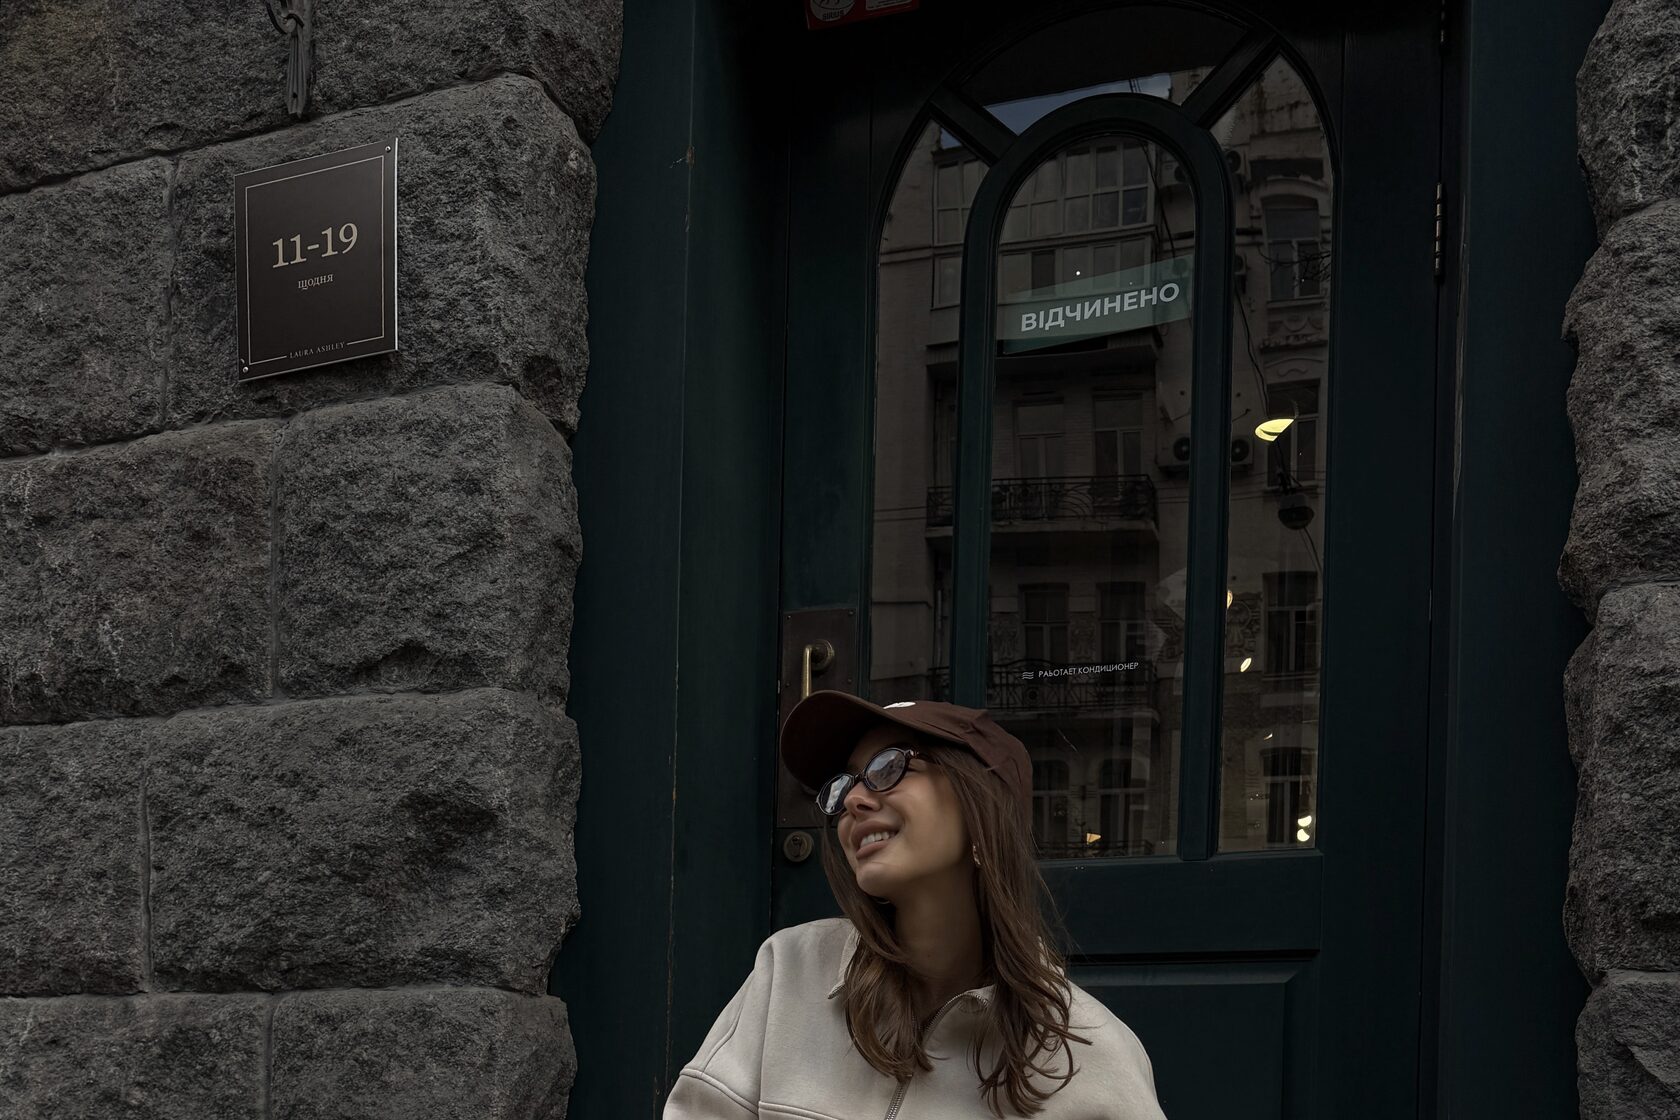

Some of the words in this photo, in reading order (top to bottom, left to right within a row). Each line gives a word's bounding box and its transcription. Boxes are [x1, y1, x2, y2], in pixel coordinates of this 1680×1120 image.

[272, 222, 358, 268] 11-19
[298, 274, 334, 290] щодня
[1020, 282, 1180, 332] ВІДЧИНЕНО
[289, 347, 314, 359] LAURA
[315, 341, 345, 354] ASHLEY
[1078, 662, 1139, 675] КОНДИЦИОНЕР
